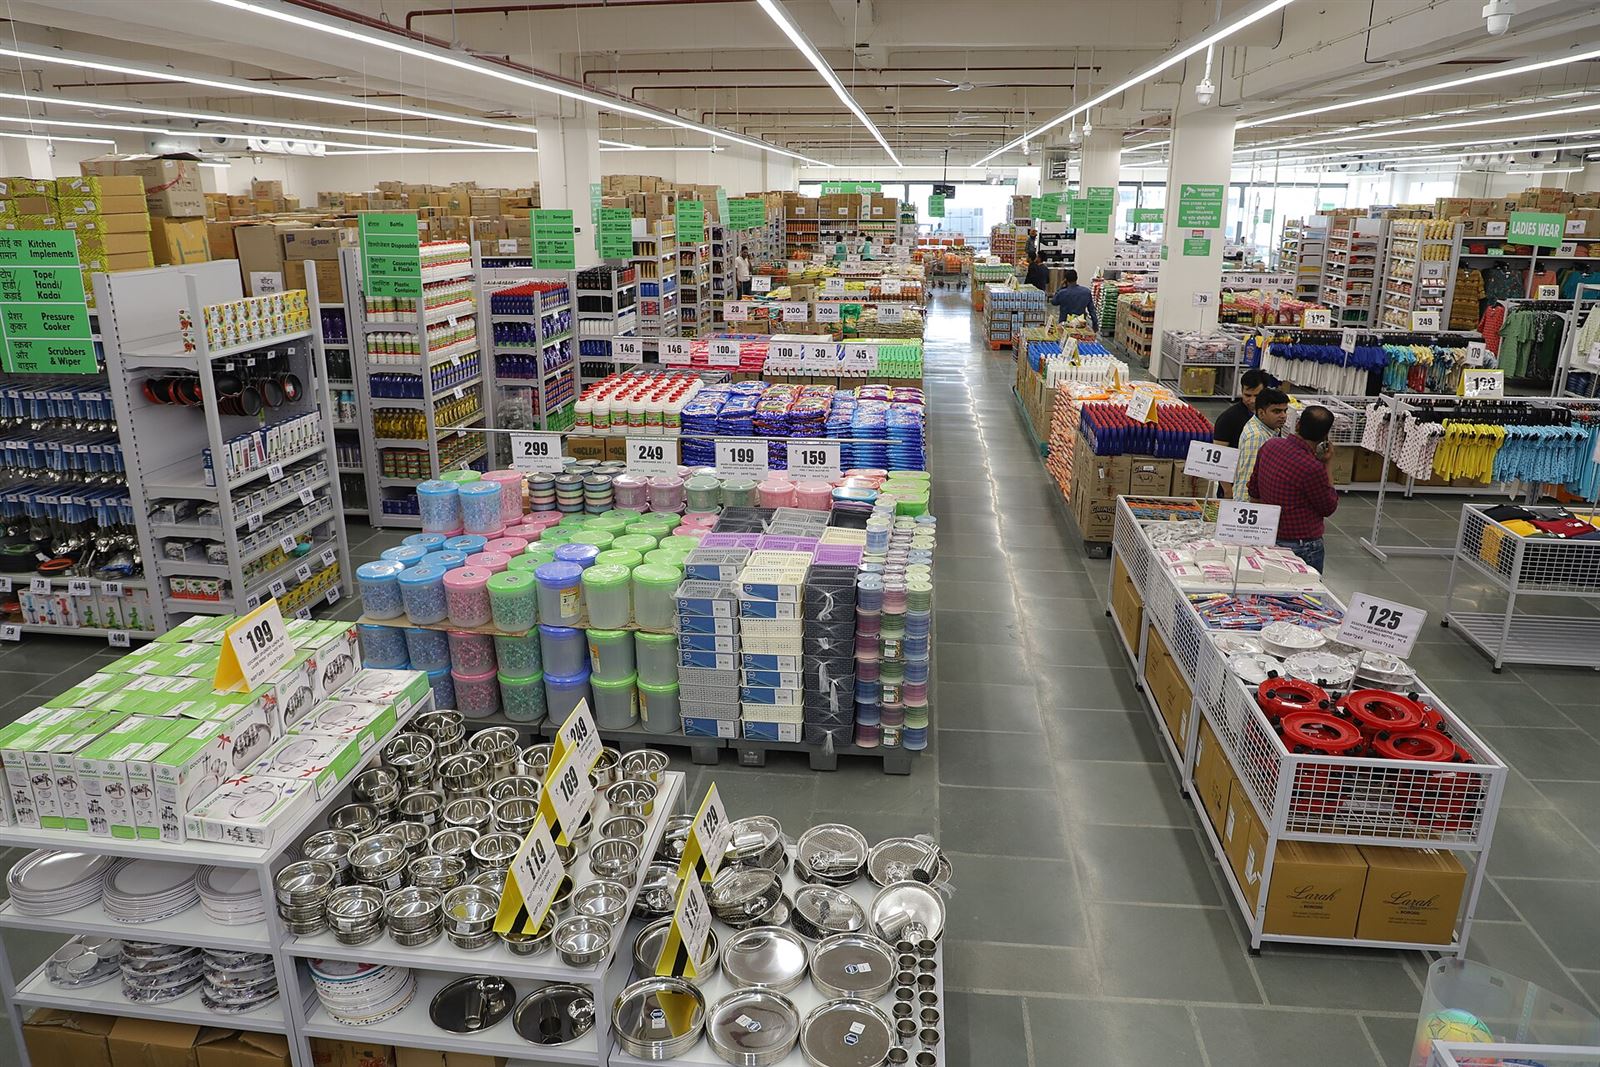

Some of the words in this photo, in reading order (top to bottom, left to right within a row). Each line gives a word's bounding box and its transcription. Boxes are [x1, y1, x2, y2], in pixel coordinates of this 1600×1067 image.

[1512, 221, 1536, 235] LADIES
[1538, 222, 1560, 238] WEAR
[28, 240, 57, 248] Kitchen
[30, 249, 74, 259] Implements
[37, 291, 62, 300] Kadai
[1542, 288, 1556, 297] 299
[731, 305, 740, 313] 20
[818, 307, 833, 315] 200
[41, 312, 75, 322] Pressure
[1418, 317, 1433, 326] 249
[43, 322, 71, 331] Cooker
[48, 347, 86, 356] Scrubbers
[619, 343, 635, 353] 146
[667, 344, 682, 354] 146
[716, 345, 730, 354] 100
[777, 347, 793, 357] 100
[1471, 347, 1481, 359] 179
[814, 349, 826, 358] 30
[855, 349, 867, 359] 45
[50, 357, 56, 365] &
[57, 357, 81, 367] Wiper
[524, 442, 549, 456] 299
[638, 445, 664, 460] 249
[729, 448, 754, 463] 199
[801, 450, 827, 465] 159
[1206, 448, 1222, 464] 19
[1237, 508, 1258, 525] 35
[36, 580, 45, 588] 79
[1367, 605, 1403, 630] 125
[6, 627, 15, 635] 29
[246, 619, 274, 654] 199
[570, 716, 588, 748] 249
[560, 765, 579, 802] 169
[703, 804, 719, 839] 129
[526, 838, 546, 881] 119
[1286, 885, 1342, 901] Larah
[1382, 891, 1440, 908] Larah
[685, 888, 699, 929] 119
